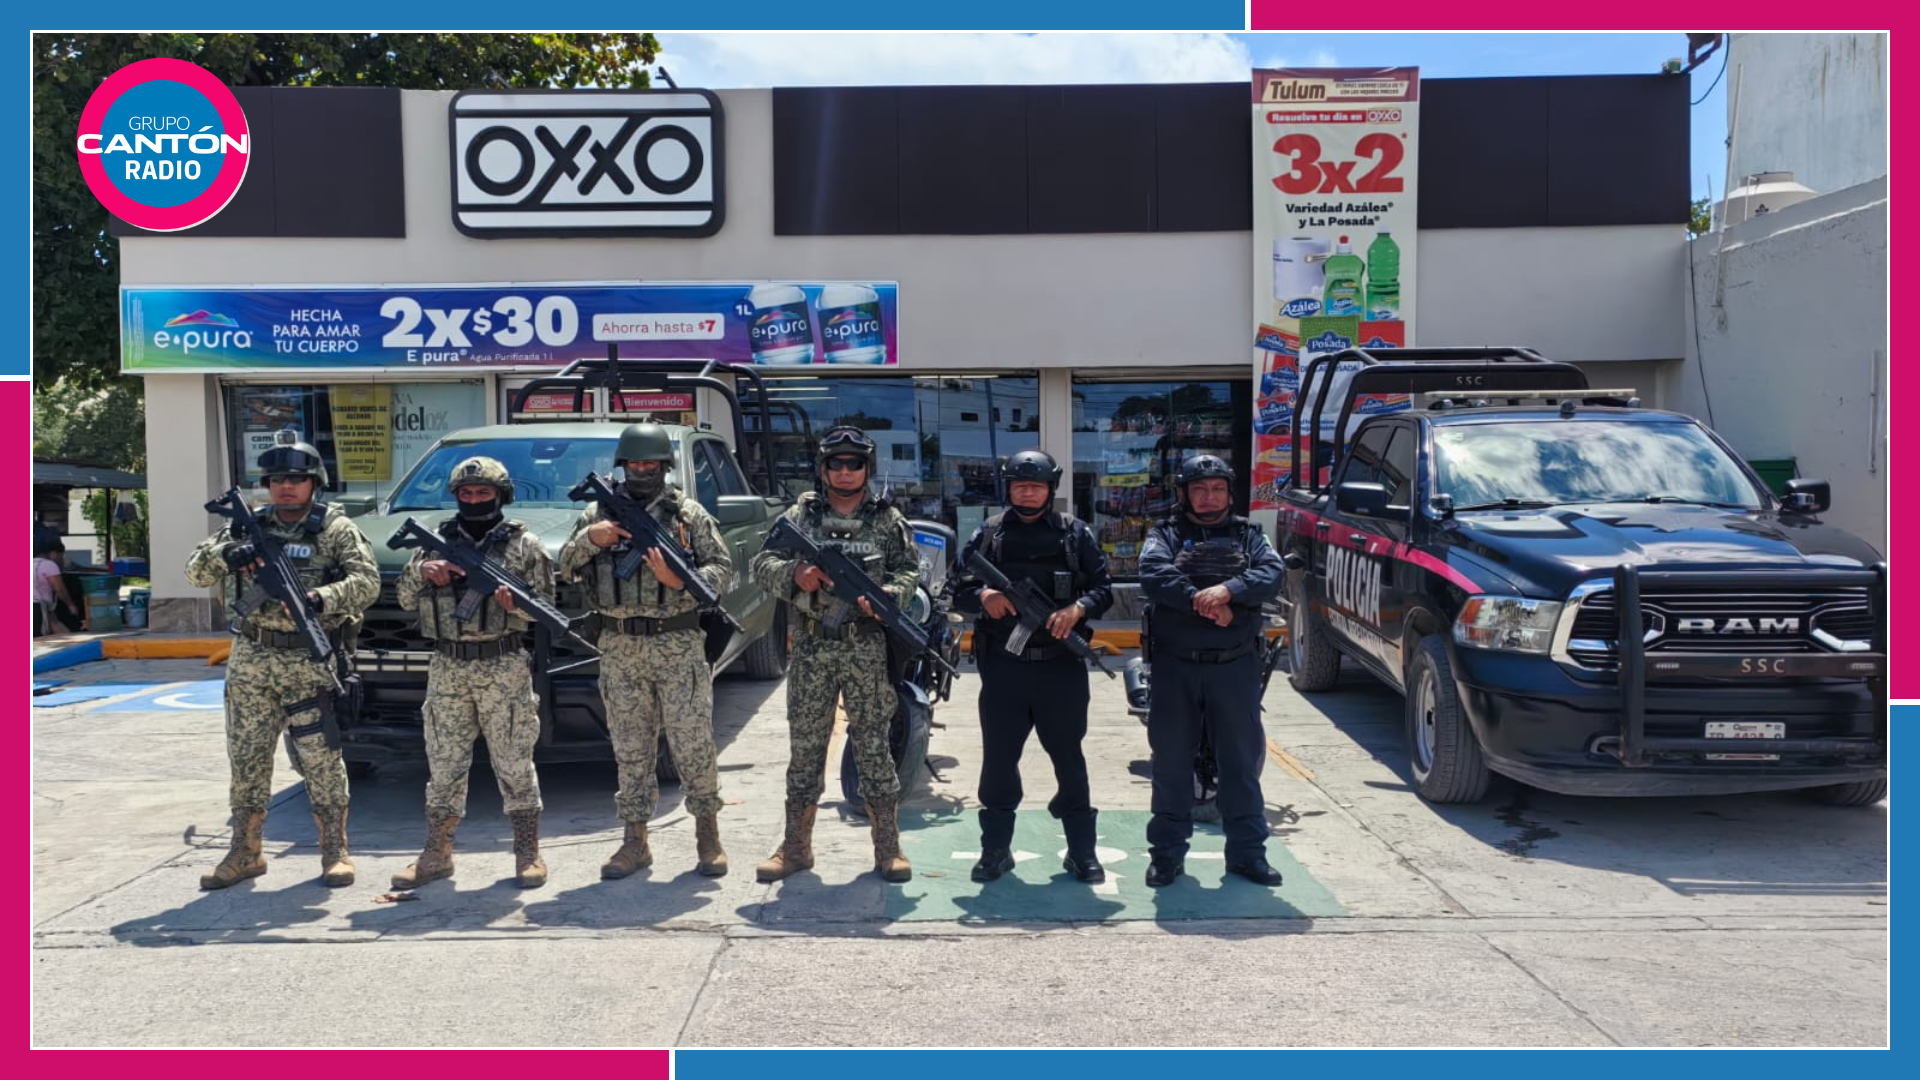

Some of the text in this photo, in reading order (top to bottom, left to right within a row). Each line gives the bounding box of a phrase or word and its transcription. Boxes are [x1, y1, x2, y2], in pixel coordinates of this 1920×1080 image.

[1270, 80, 1326, 100] Tulum
[1368, 109, 1401, 122] OXXO
[465, 118, 704, 203] OXXO
[1286, 203, 1343, 213] Variedad
[1298, 218, 1307, 229] y
[1309, 216, 1325, 226] La
[291, 309, 343, 322] HECHA
[735, 304, 753, 316] 1L
[273, 325, 361, 337] PARA AMAR
[601, 319, 716, 334] Ahorra hasta $7
[275, 340, 359, 352] TU CUERPO
[1312, 339, 1347, 349] Posada
[407, 350, 417, 361] E
[470, 354, 492, 362] Agua
[624, 396, 684, 407] Bienvenido
[1678, 618, 1800, 634] RAM
